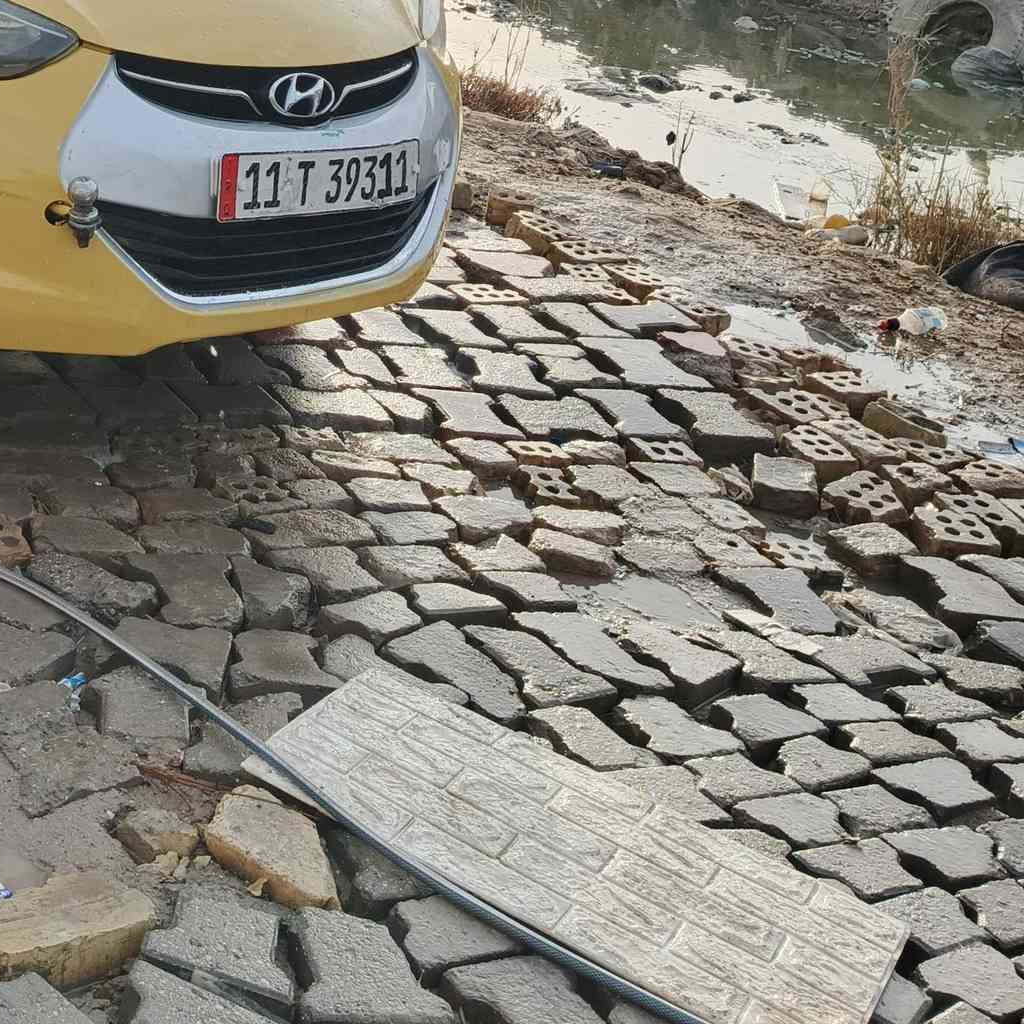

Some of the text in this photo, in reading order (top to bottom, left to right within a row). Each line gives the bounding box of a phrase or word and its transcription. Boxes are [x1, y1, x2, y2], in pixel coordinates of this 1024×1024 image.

[243, 150, 408, 210] 11 T 39311
